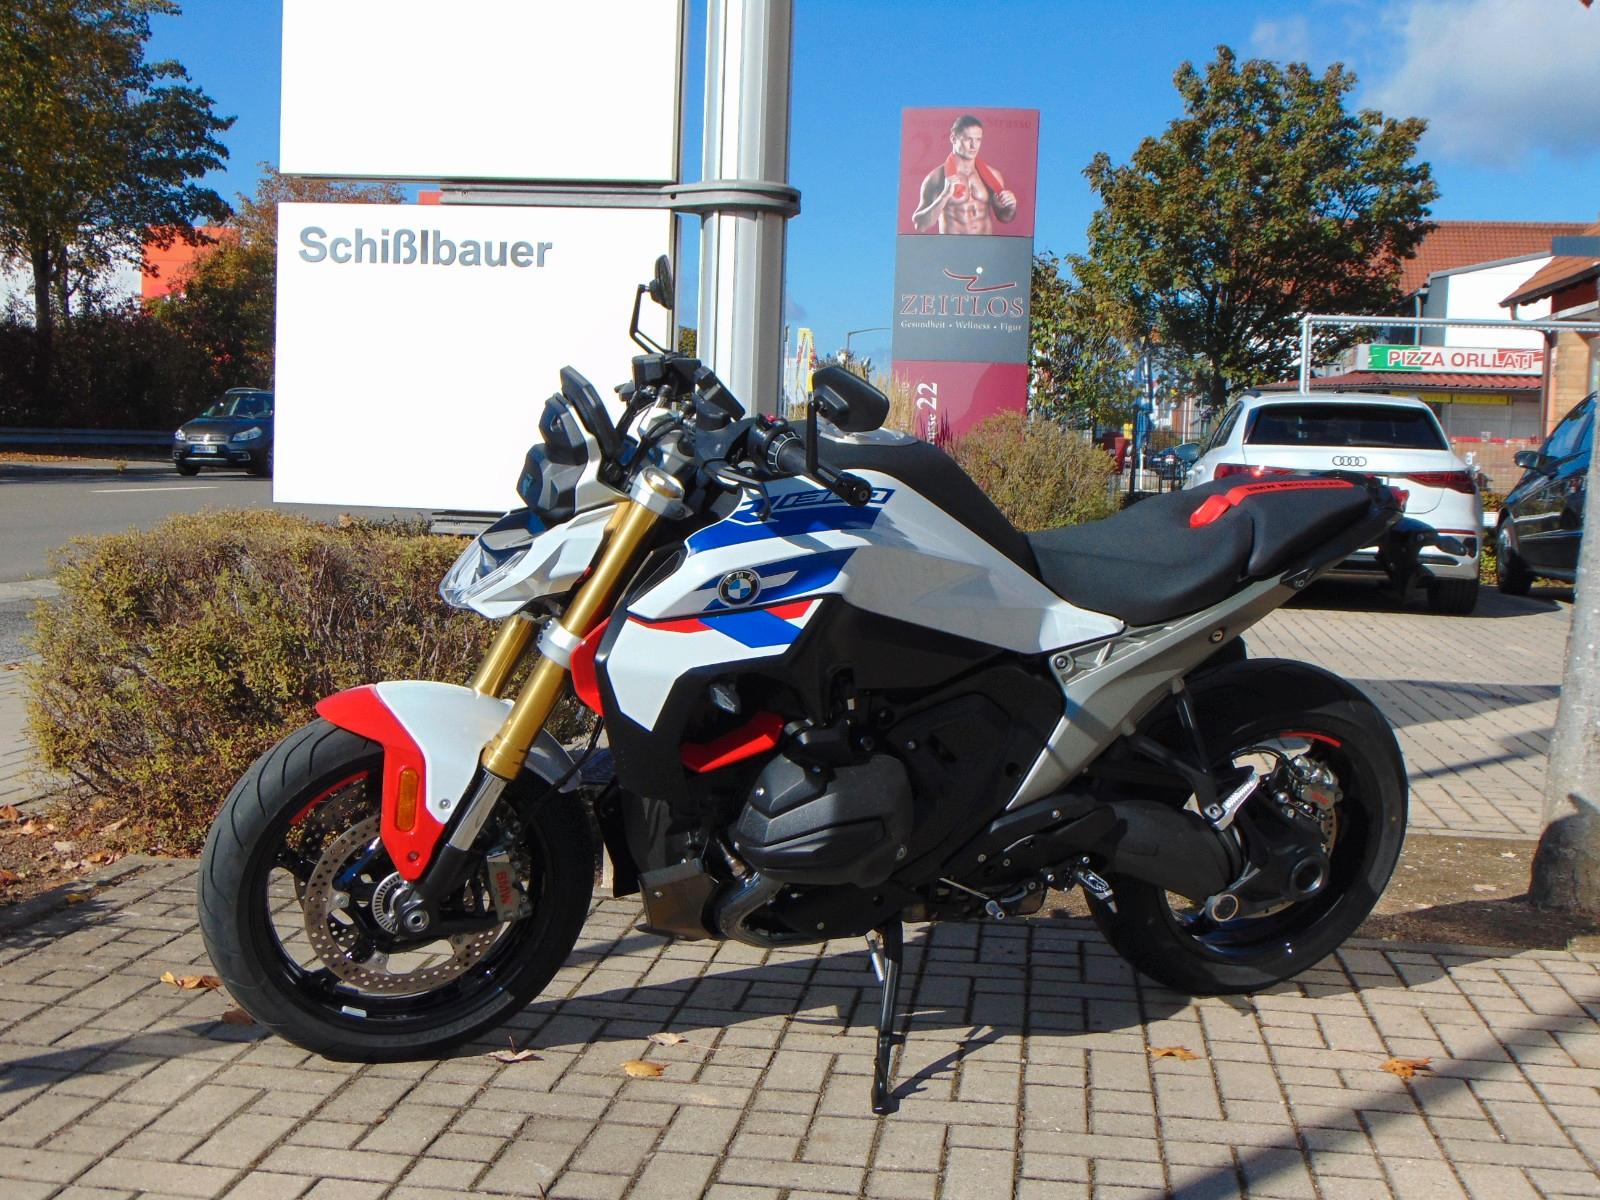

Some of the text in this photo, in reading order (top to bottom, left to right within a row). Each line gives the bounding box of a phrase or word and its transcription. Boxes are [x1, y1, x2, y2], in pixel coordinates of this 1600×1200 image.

[298, 226, 553, 268] Schißlbauer
[900, 294, 1024, 318] ZEITLOS
[900, 320, 1022, 333] Gesundheit Wellness Figur
[1388, 350, 1533, 369] PIZZA ORLLATI
[916, 382, 937, 410] 22
[495, 871, 512, 905] BMW
